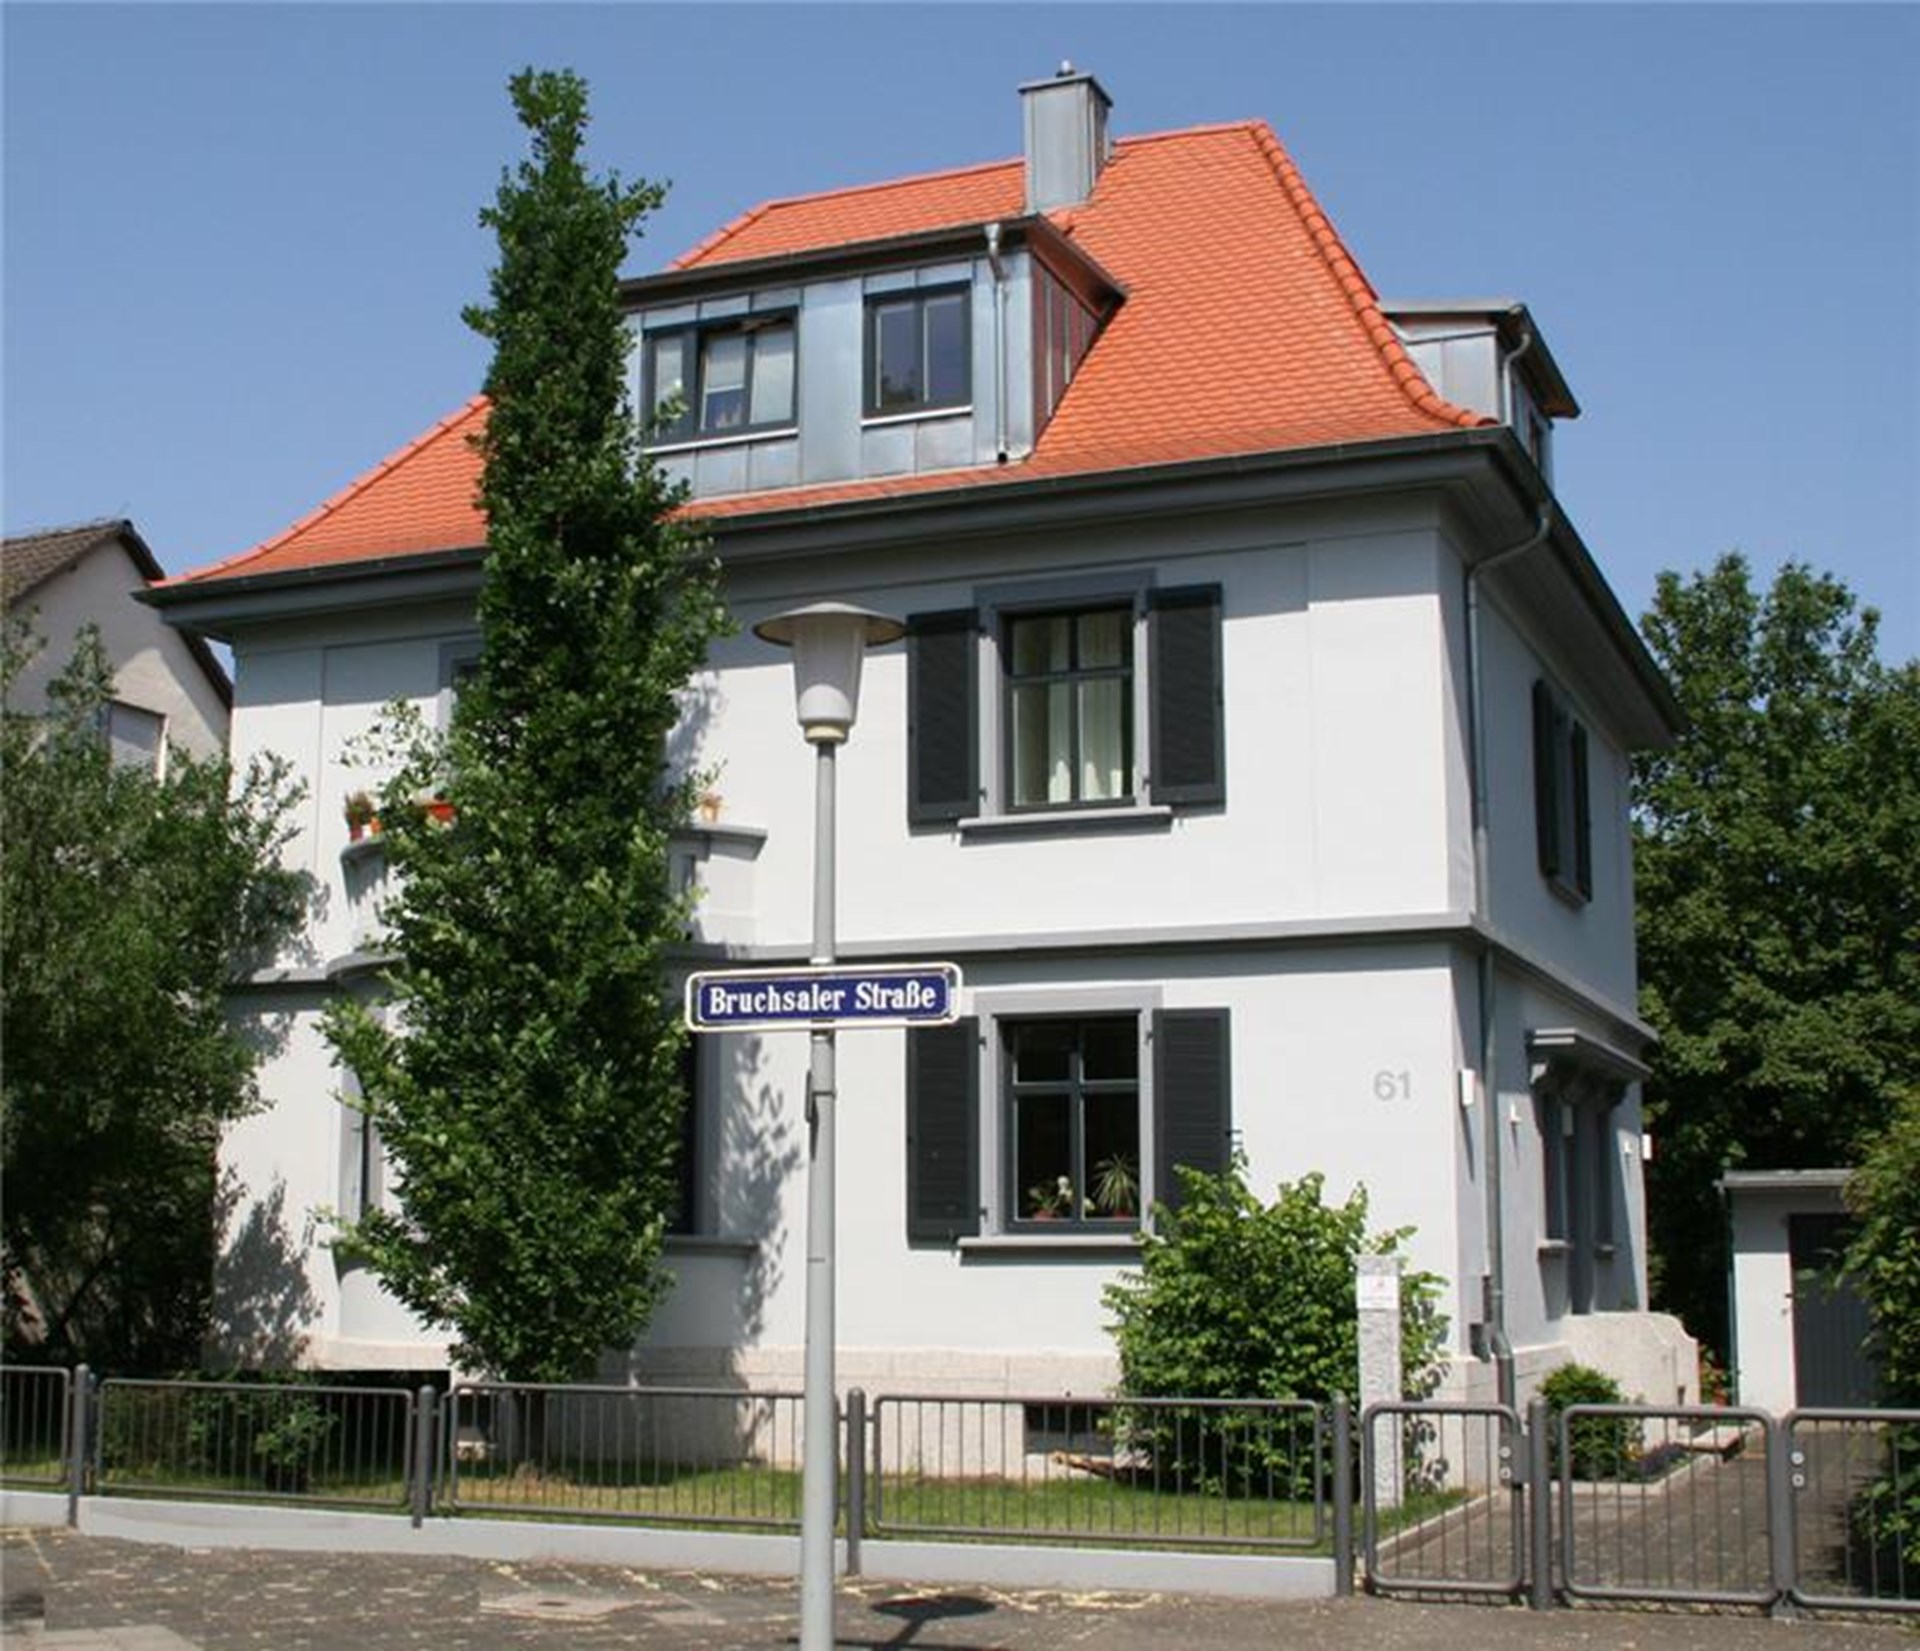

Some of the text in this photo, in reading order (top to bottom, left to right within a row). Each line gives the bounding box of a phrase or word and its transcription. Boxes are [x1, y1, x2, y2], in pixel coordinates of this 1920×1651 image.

[709, 980, 936, 1014] Bruchsaler Straße
[1374, 1070, 1411, 1101] 61
